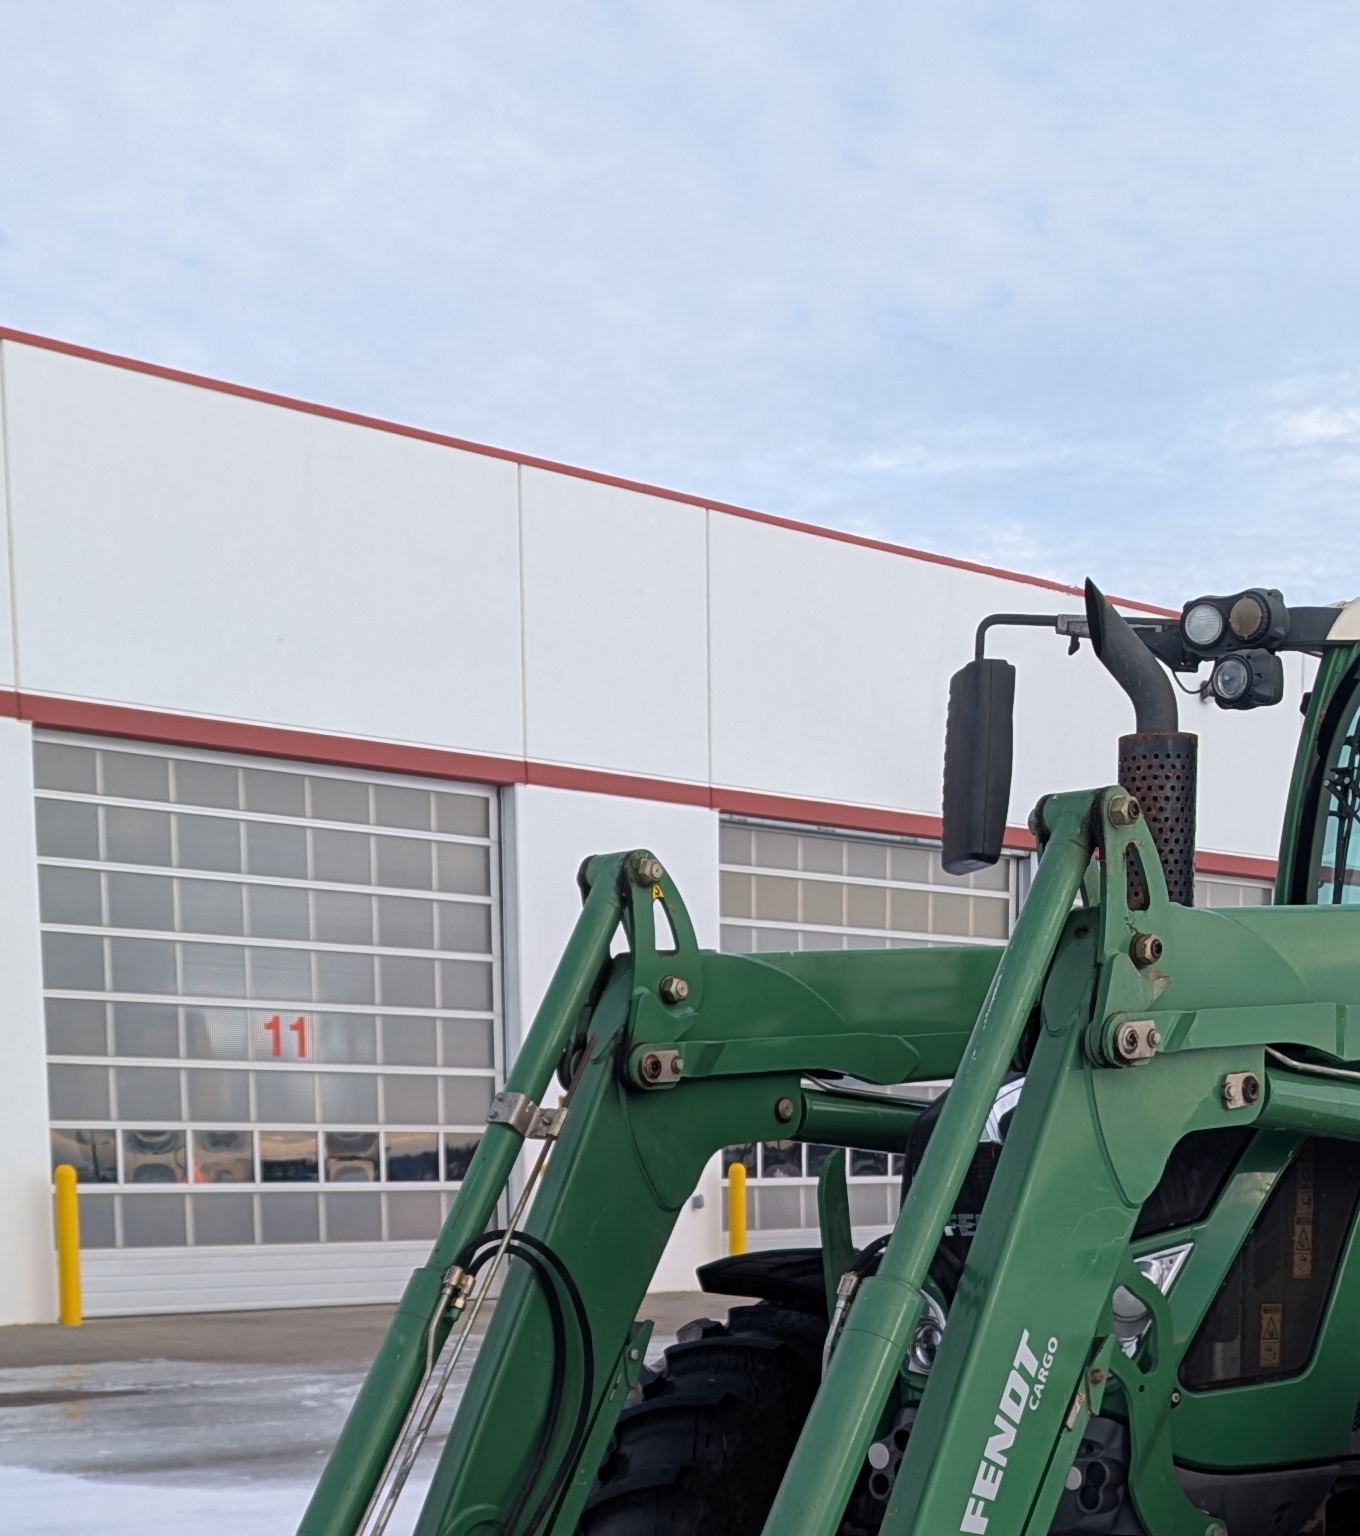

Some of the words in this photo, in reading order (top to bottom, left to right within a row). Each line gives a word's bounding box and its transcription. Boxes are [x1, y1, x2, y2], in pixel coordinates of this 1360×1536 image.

[263, 1014, 306, 1059] 11
[1028, 1336, 1058, 1411] CARGO
[960, 1328, 1039, 1535] FENDT
